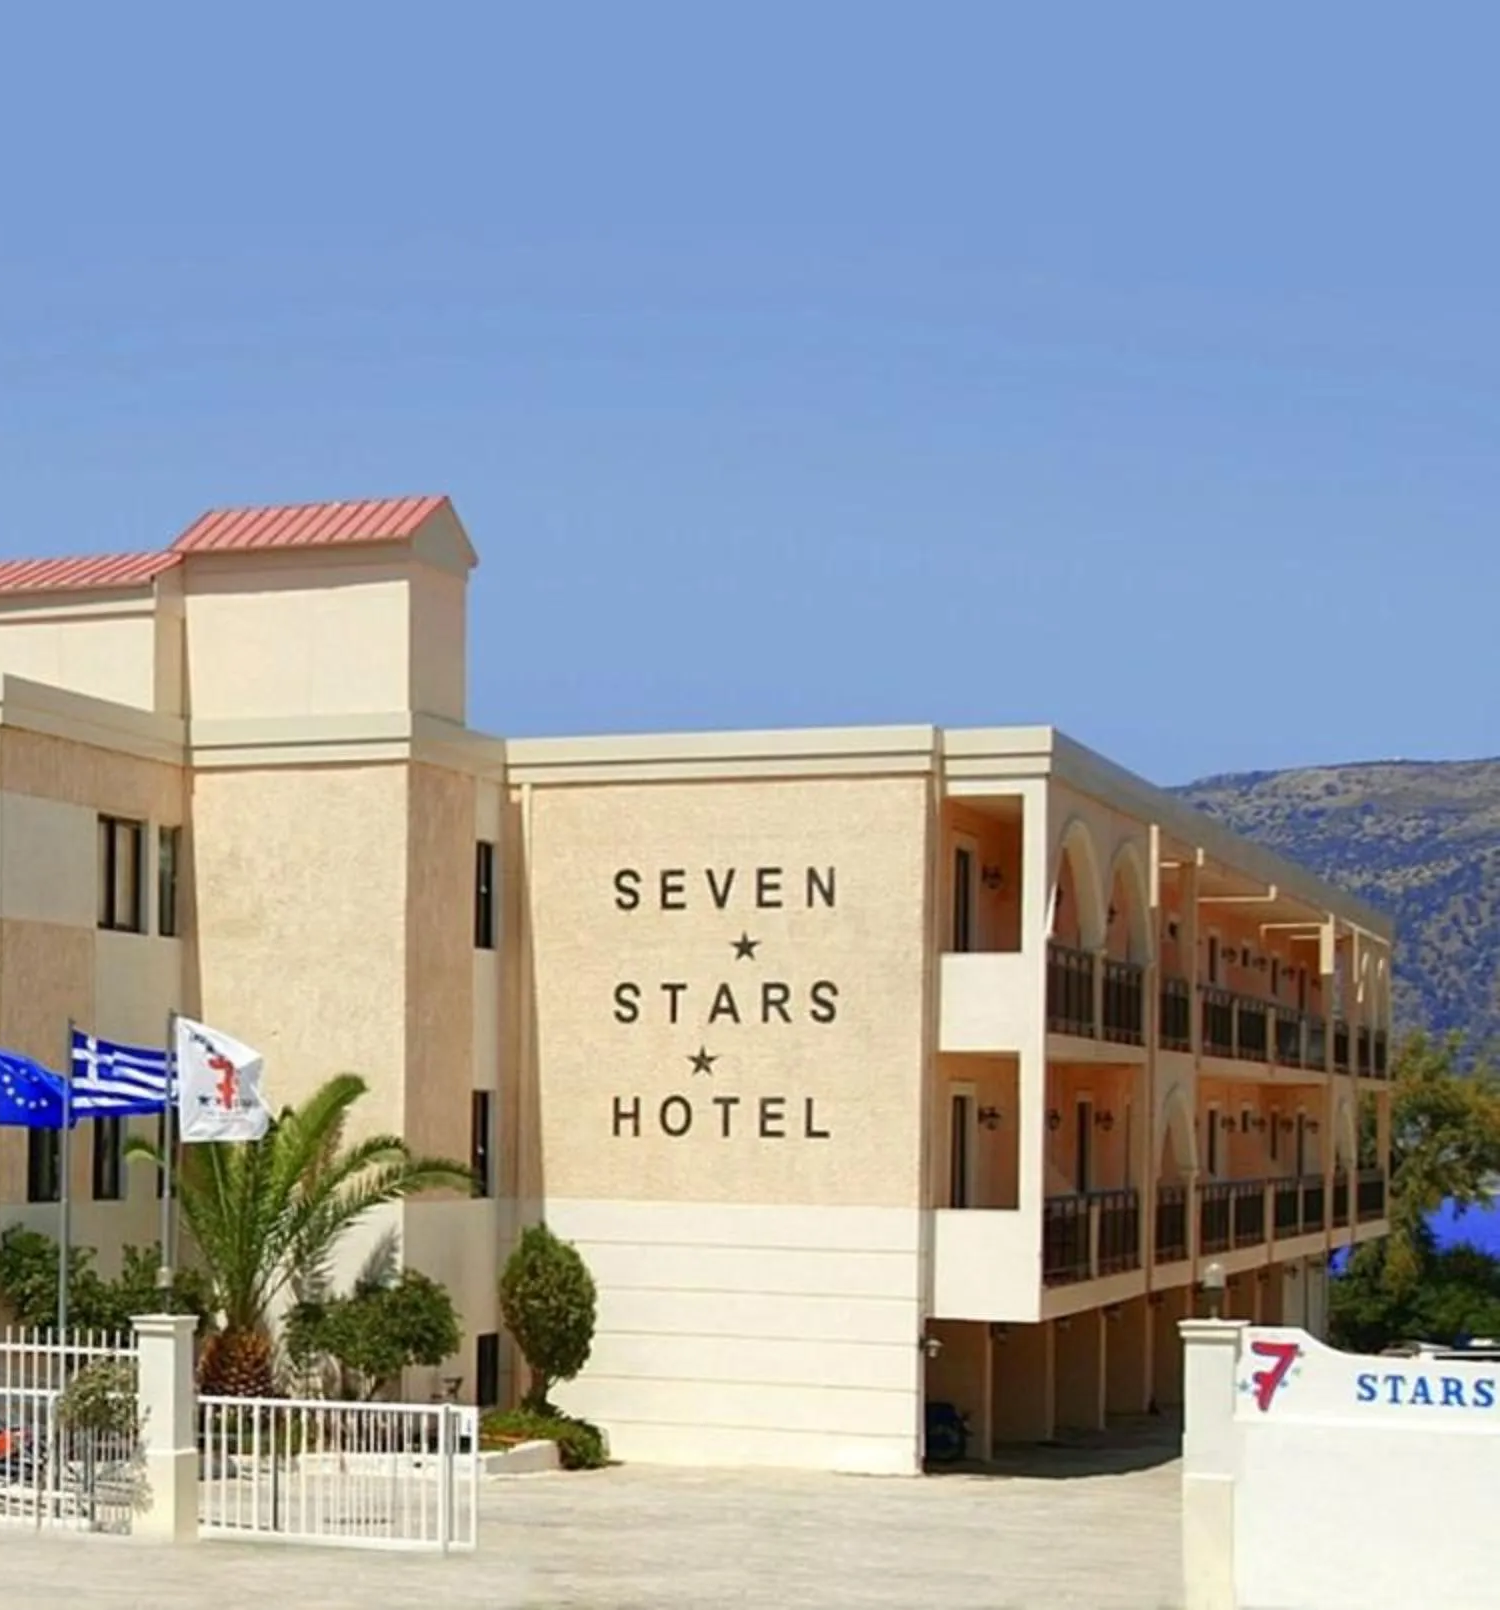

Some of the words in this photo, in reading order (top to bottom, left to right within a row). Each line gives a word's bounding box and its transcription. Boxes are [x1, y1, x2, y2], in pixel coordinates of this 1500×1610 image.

[613, 867, 836, 910] SEVEN
[613, 980, 839, 1024] STARS
[612, 1095, 831, 1139] HOTEL
[1251, 1341, 1299, 1412] 7
[1356, 1373, 1496, 1408] STARS
